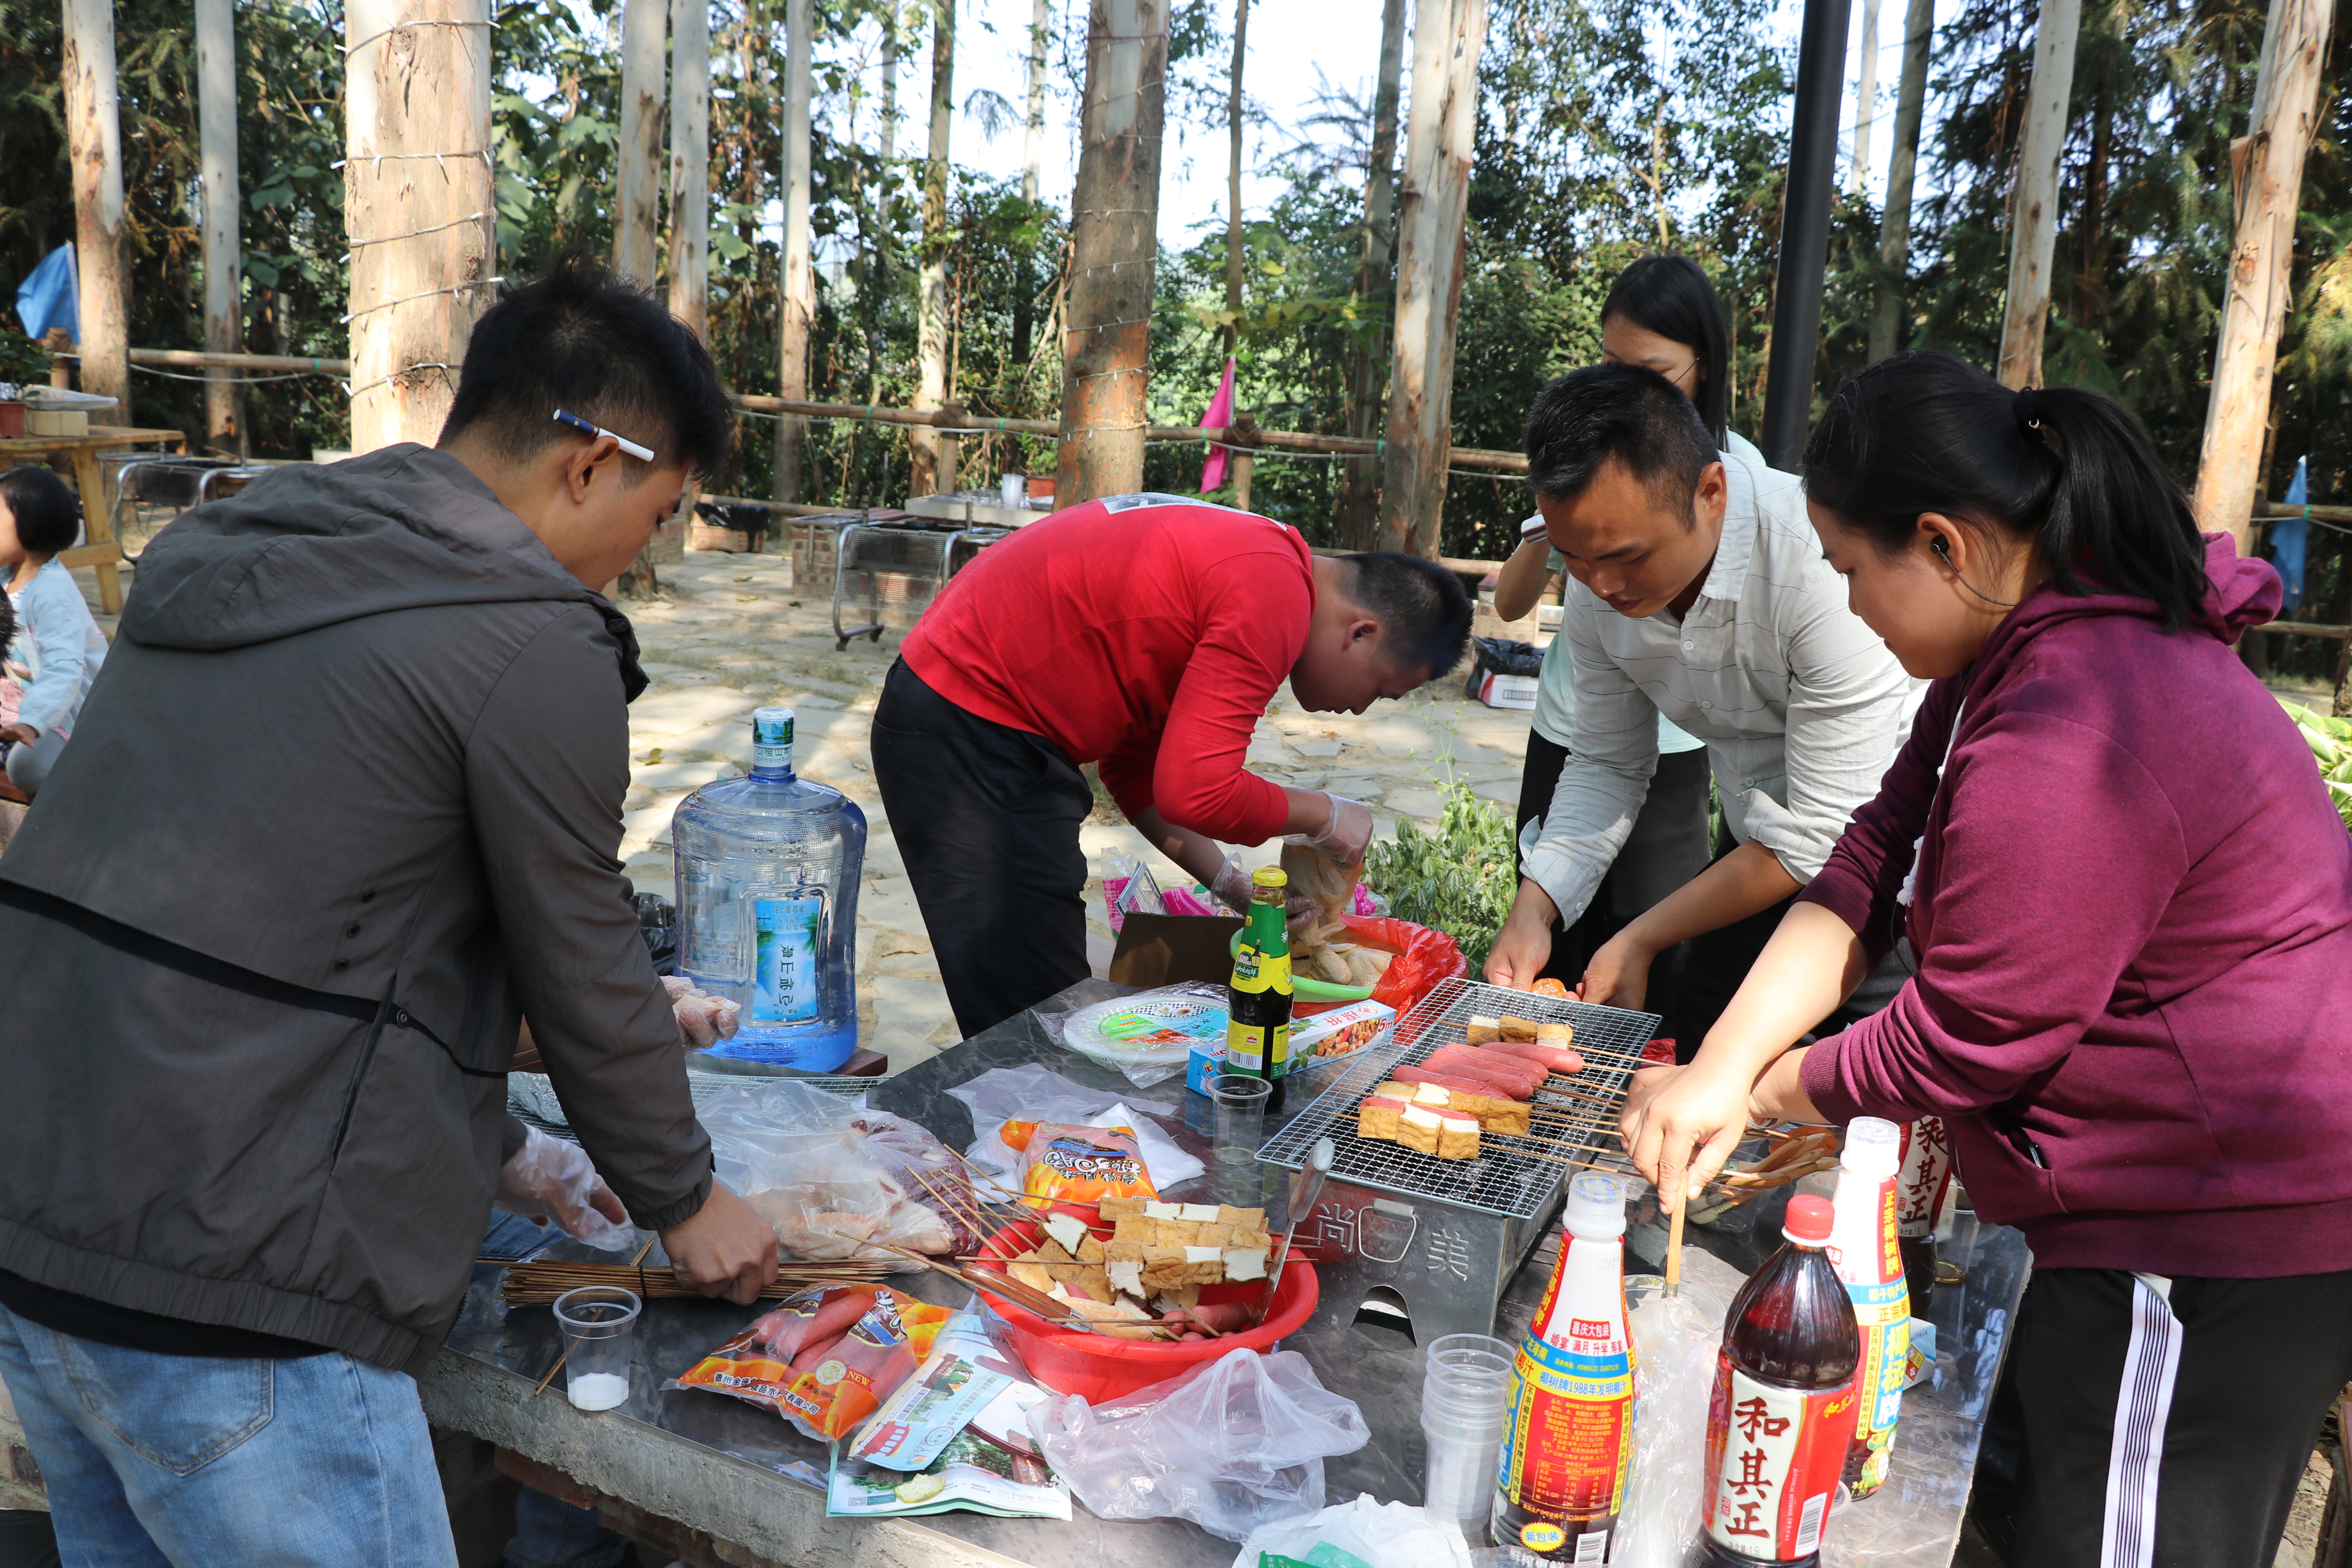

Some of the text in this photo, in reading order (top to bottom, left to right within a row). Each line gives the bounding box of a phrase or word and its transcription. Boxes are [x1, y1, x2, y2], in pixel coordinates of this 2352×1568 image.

[778, 944, 795, 1006] 心怡山泉
[1323, 1010, 1362, 1027] 锡纸
[1377, 1017, 1393, 1033] 5m
[1043, 1151, 1142, 1176] 热狗肠
[1316, 1203, 1469, 1282] 尚 美
[1883, 1190, 1900, 1276] 正宗椰树牌
[1572, 1321, 1610, 1338] 喜庆大包装
[1550, 1332, 1623, 1356] 婚宴 满月 升学 寿宴
[847, 1370, 870, 1386] NEW
[1540, 1371, 1626, 1397] 椰树牌1988年发明椰汁
[1725, 1396, 1790, 1538] 和其正
[1525, 1531, 1560, 1543] 新包装
